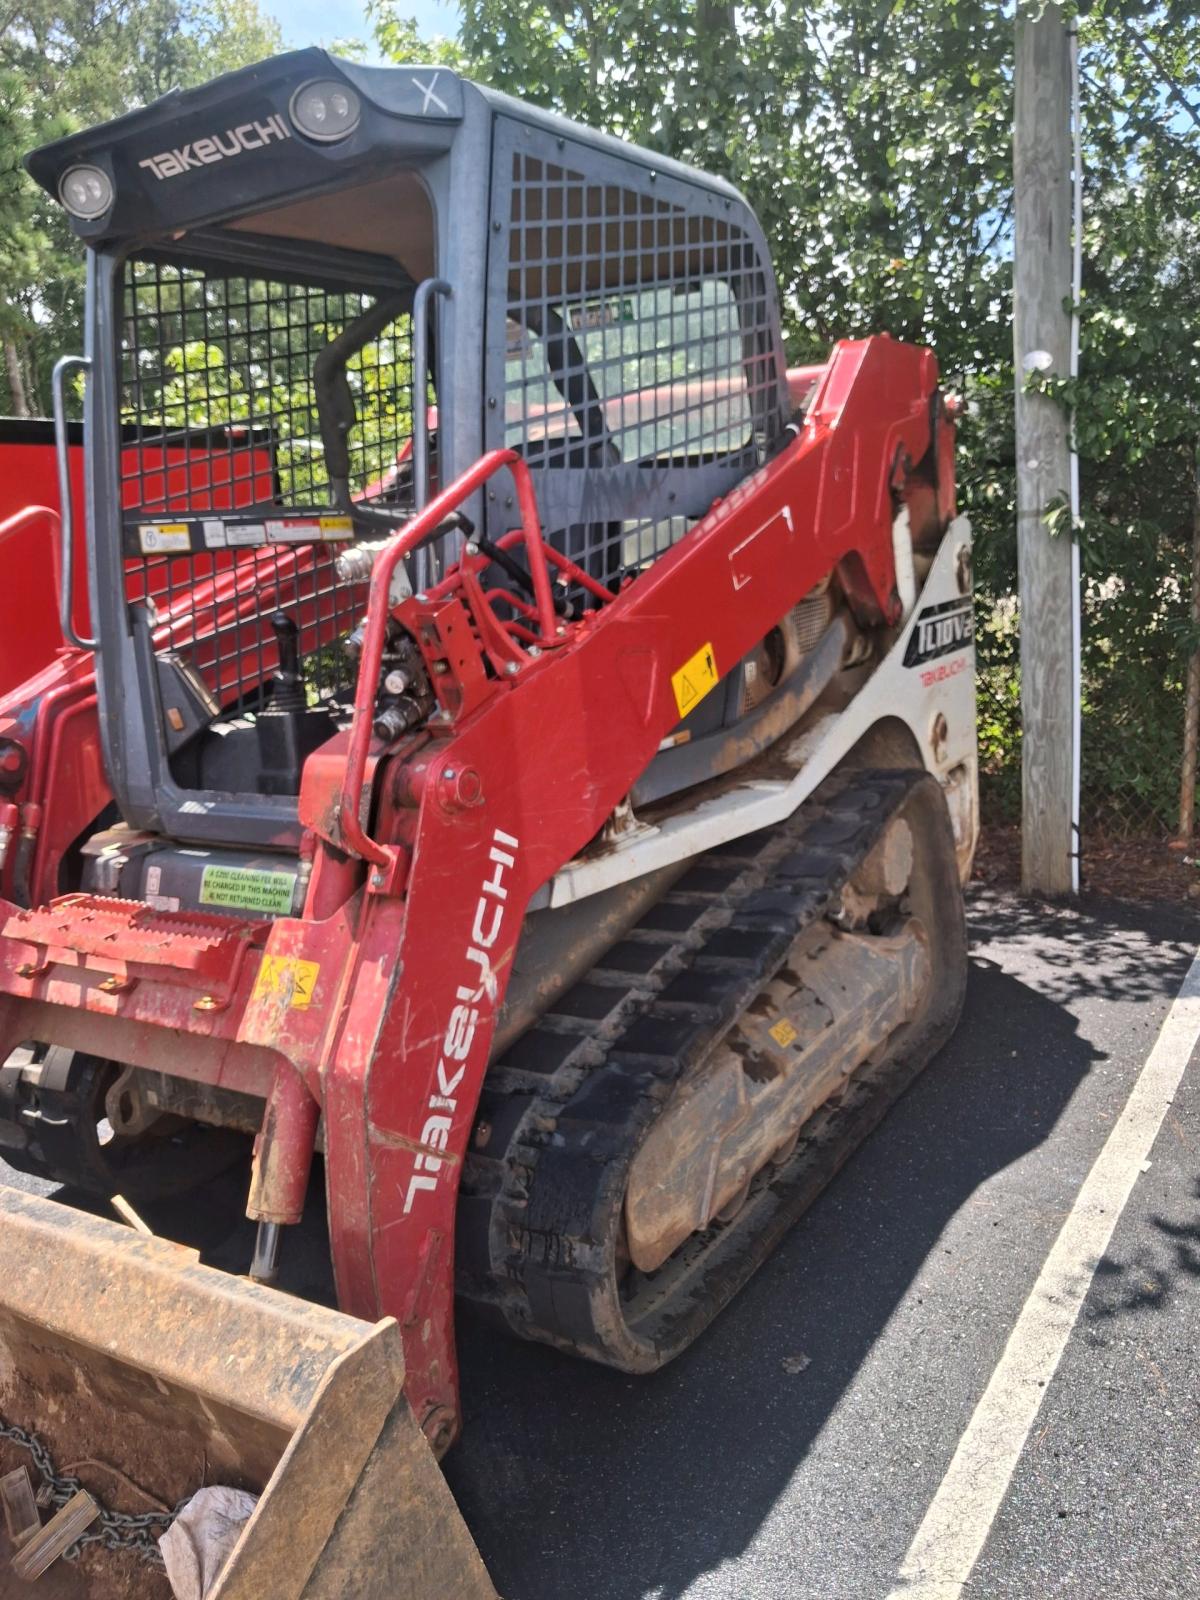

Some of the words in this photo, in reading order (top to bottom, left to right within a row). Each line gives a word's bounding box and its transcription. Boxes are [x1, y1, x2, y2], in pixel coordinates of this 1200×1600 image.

[230, 872, 260, 882] CLEANING
[260, 875, 272, 884] FEE
[273, 877, 288, 885] WILL
[204, 879, 211, 888] BE
[212, 880, 240, 892] CHARGED
[247, 885, 261, 894] THIS
[262, 887, 290, 897] MACHINE
[215, 893, 228, 901] NOT
[229, 894, 261, 906] RETURNED
[261, 898, 282, 908] CLEAN
